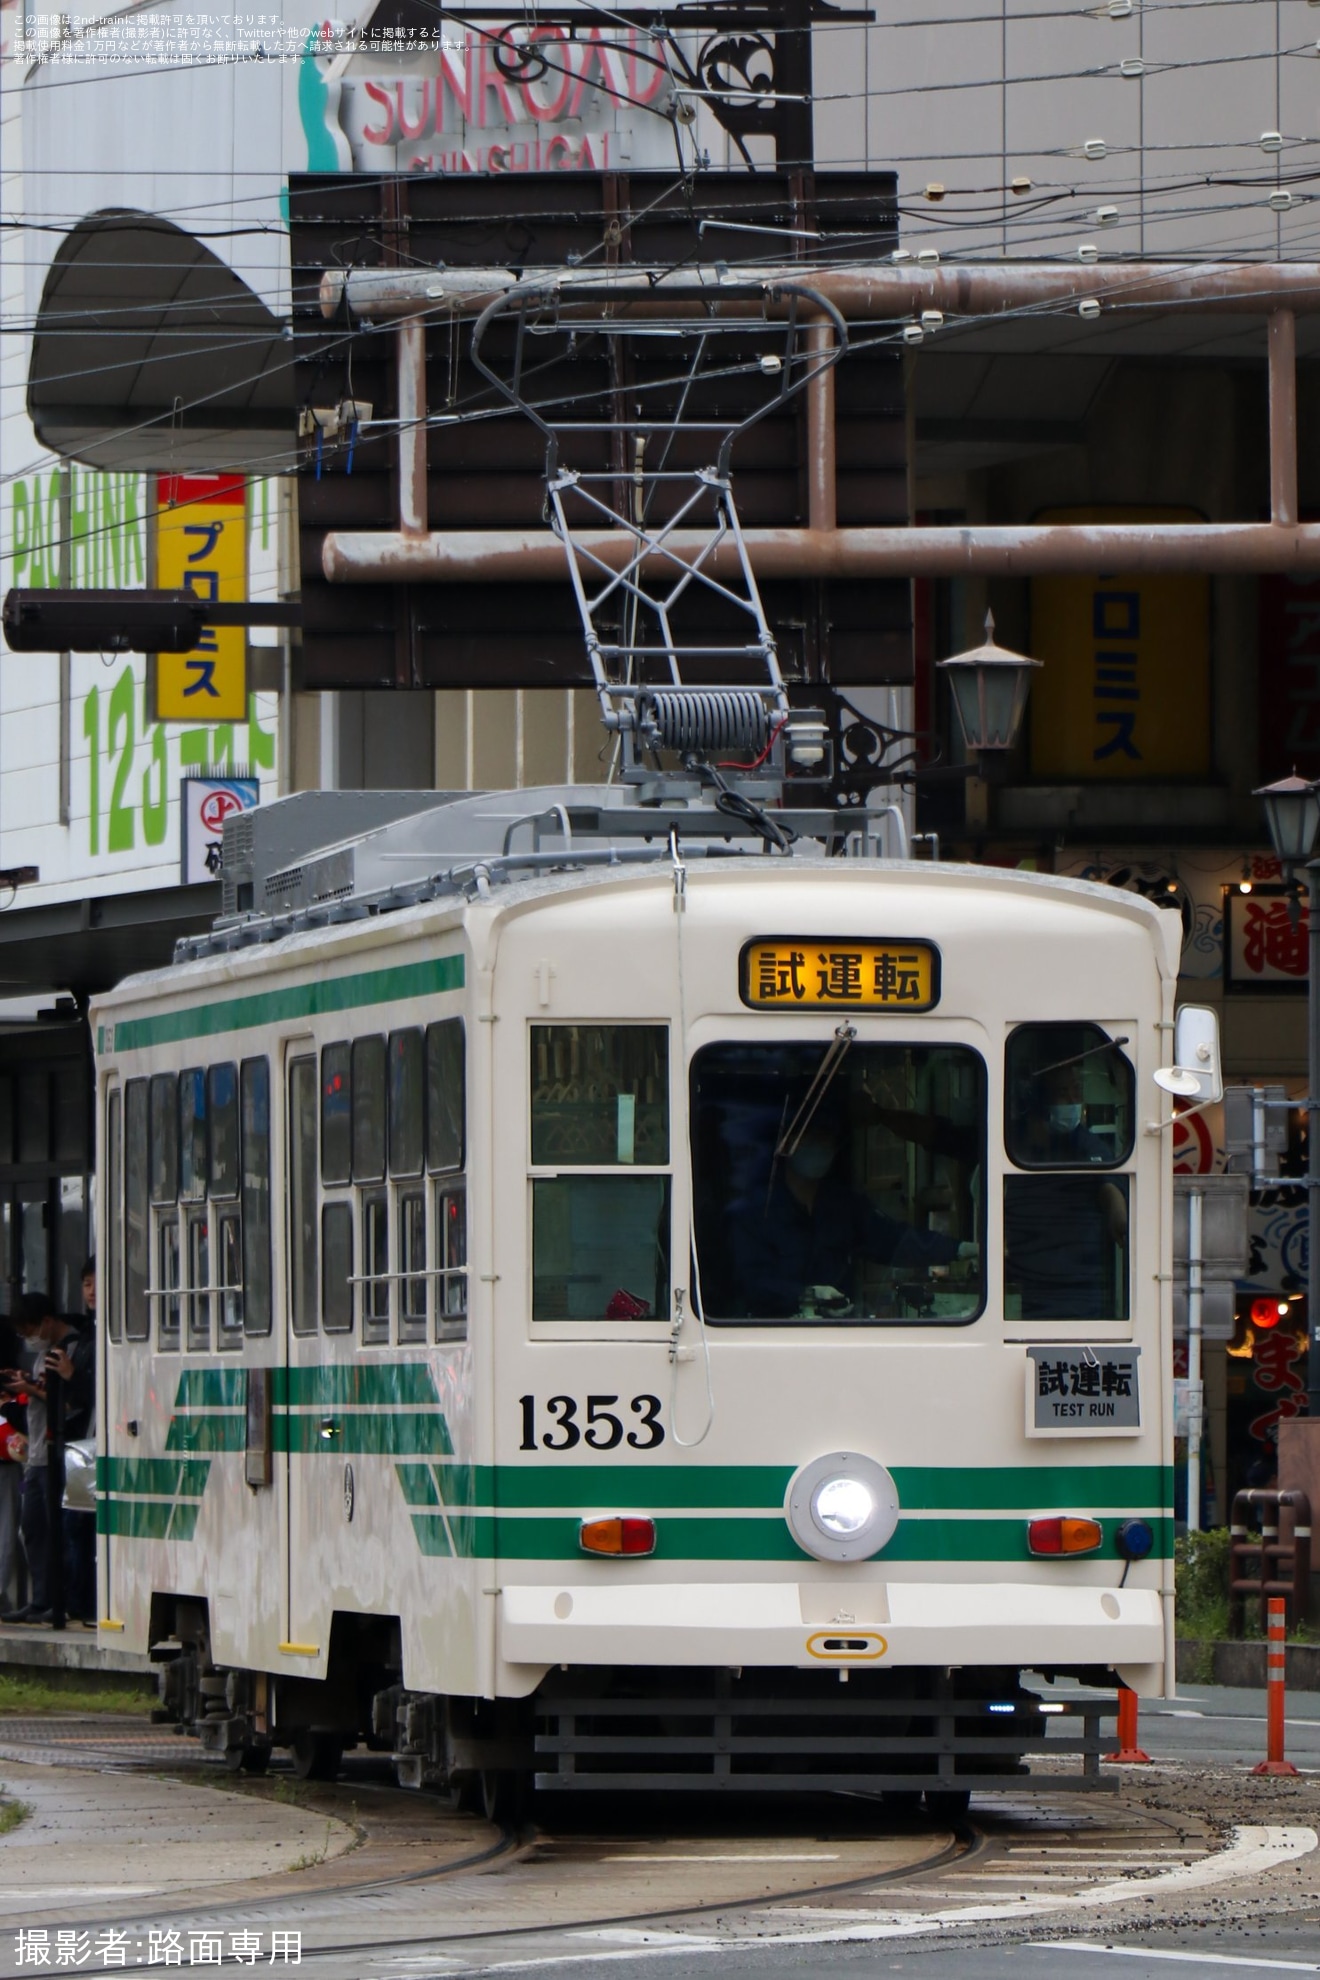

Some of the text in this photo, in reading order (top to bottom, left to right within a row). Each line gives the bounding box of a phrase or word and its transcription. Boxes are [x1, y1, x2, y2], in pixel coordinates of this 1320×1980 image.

[363, 24, 667, 145] SUNROAD
[1093, 574, 1142, 760] ロミス
[758, 951, 921, 1001] 試運転
[1038, 1361, 1133, 1396] 試運転
[518, 1394, 665, 1450] 1353
[1053, 1402, 1115, 1417] TEST RUN
